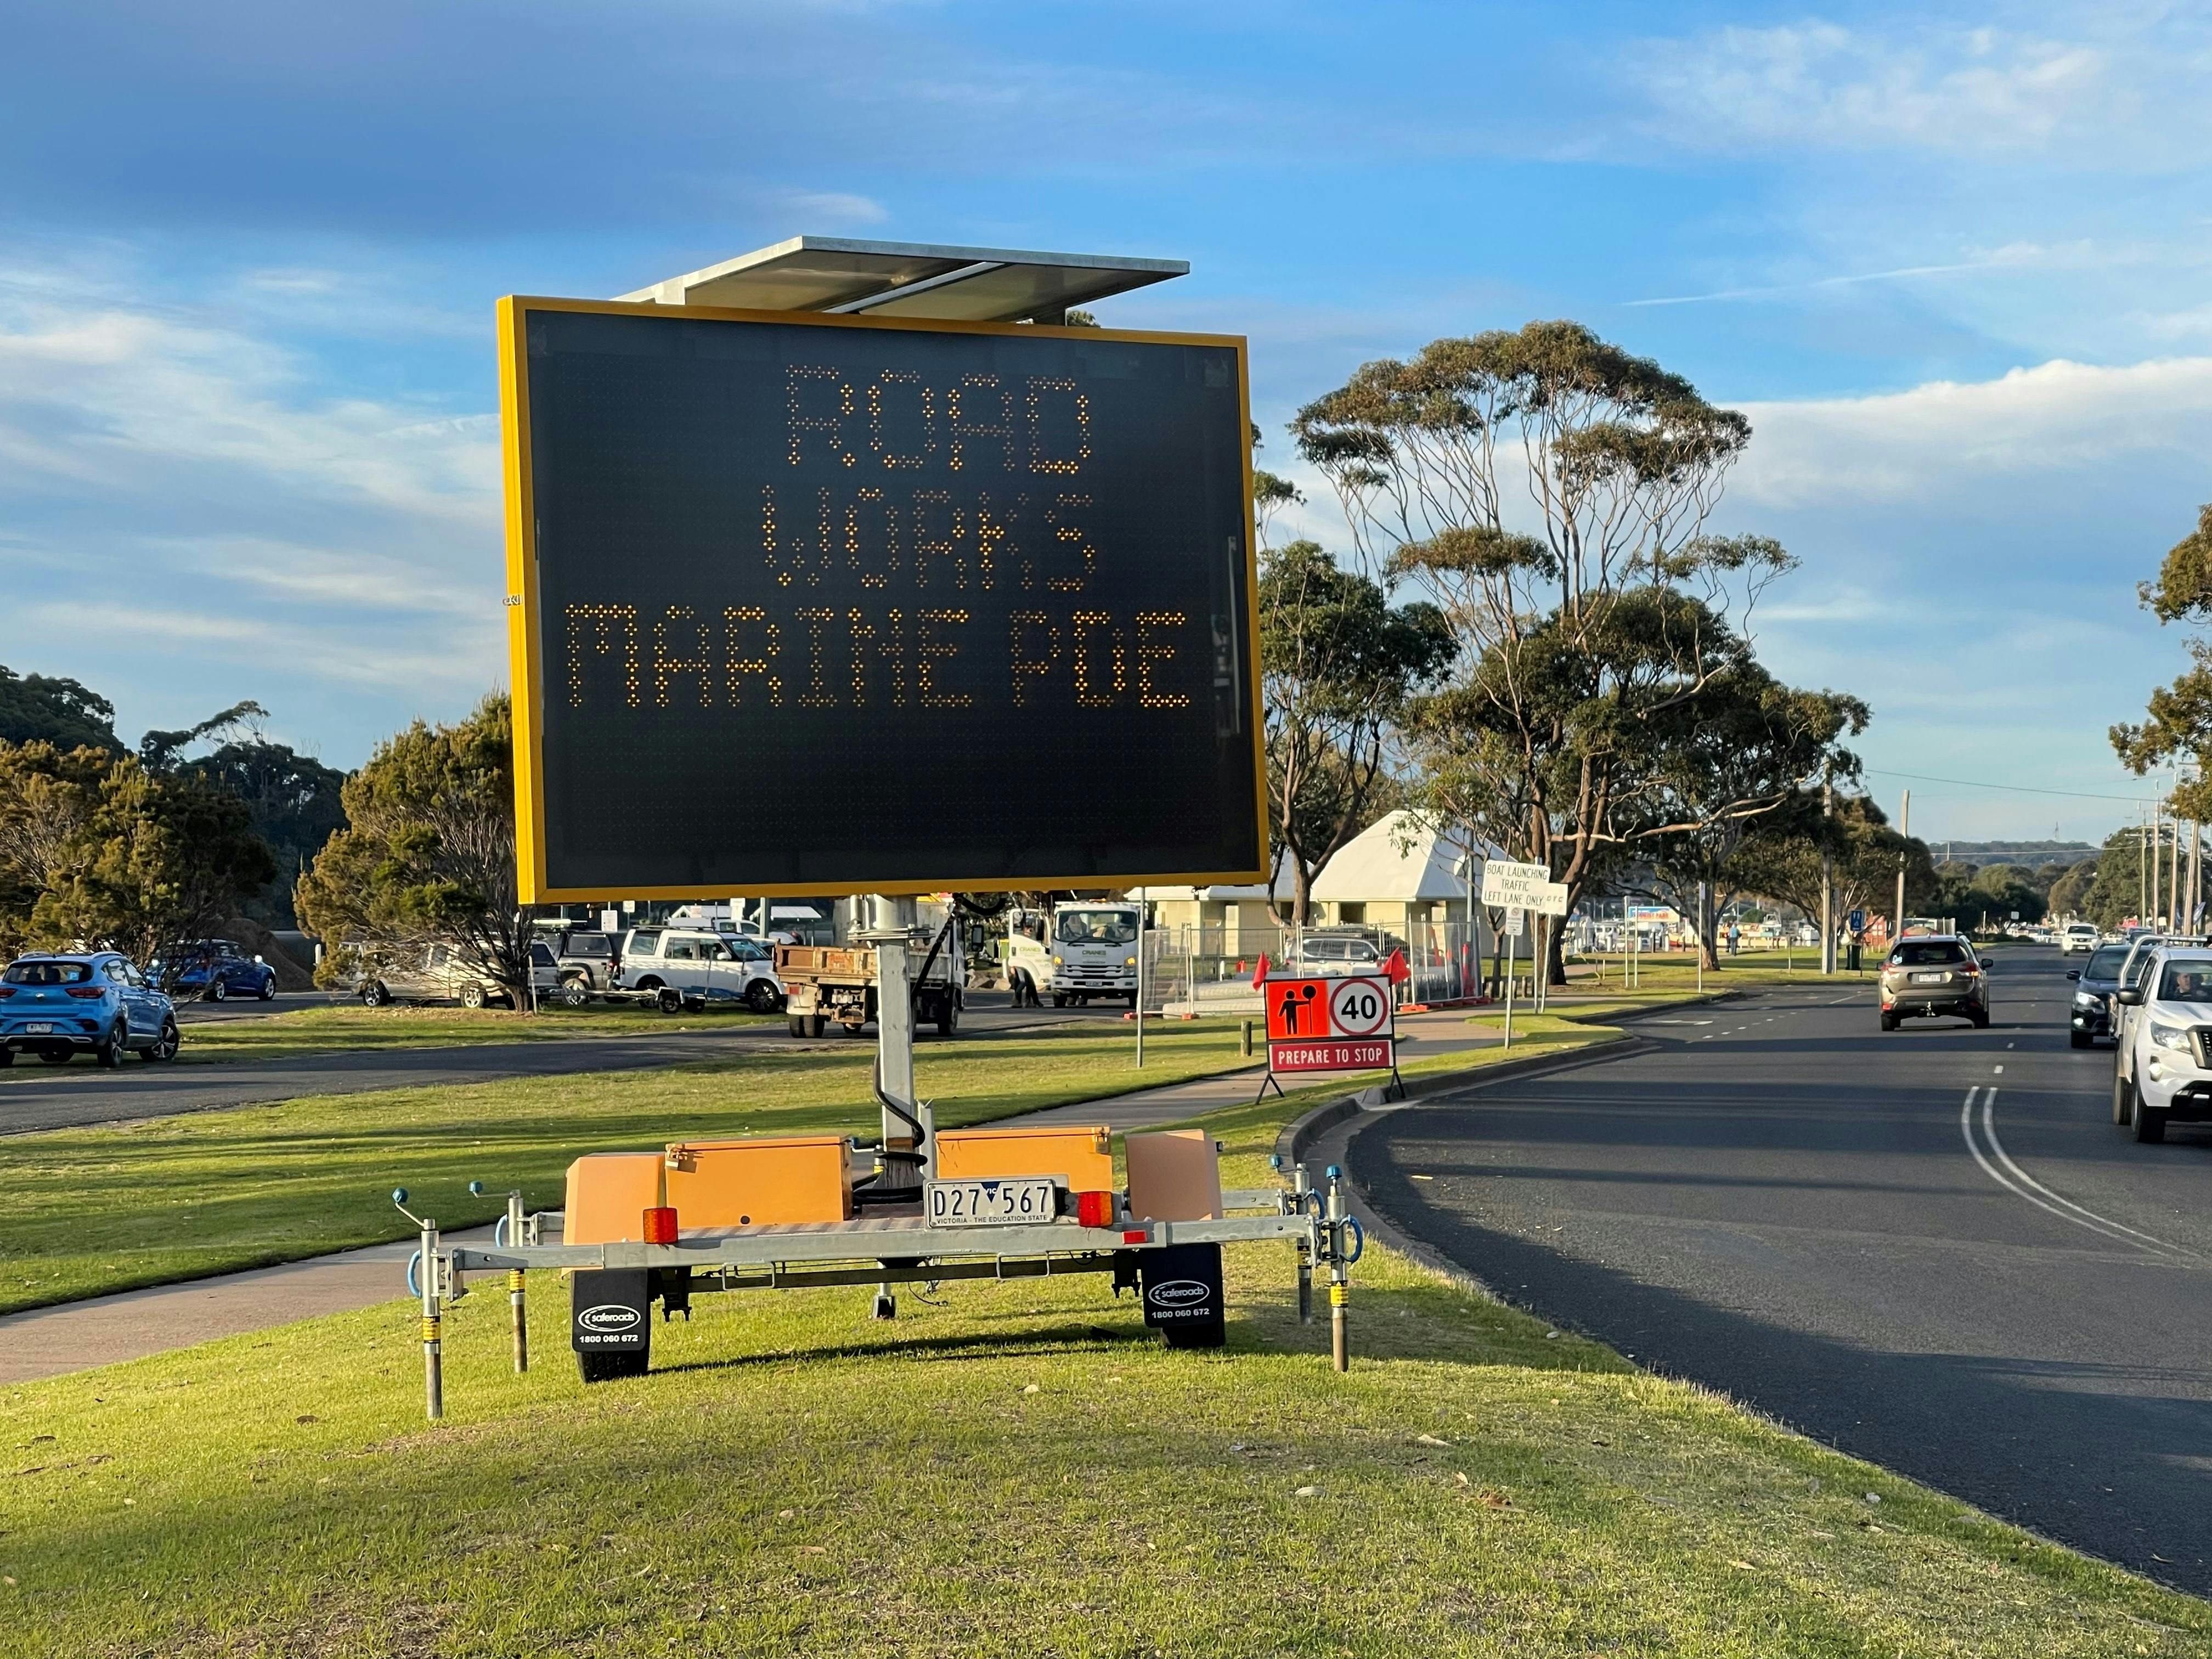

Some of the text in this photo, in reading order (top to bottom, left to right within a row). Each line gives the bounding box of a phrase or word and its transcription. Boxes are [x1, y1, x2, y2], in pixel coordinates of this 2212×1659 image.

[786, 364, 1091, 474] ROAD
[762, 484, 1095, 591] WORKS
[565, 604, 1189, 707] MARINE PDE
[1487, 864, 1548, 880] BOAT LAUNCHING
[1501, 879, 1530, 891] TRAFFIC
[1484, 890, 1544, 906] LEFT LANE ONLY
[1341, 995, 1376, 1019] 40
[1278, 1047, 1383, 1065] PREPARE TO STOP
[934, 1186, 1048, 1216] D27 567
[936, 1216, 967, 1224] VICTORIA
[1161, 1286, 1204, 1297] saferoads
[591, 1312, 635, 1322] saferoads
[602, 1335, 620, 1343] 060
